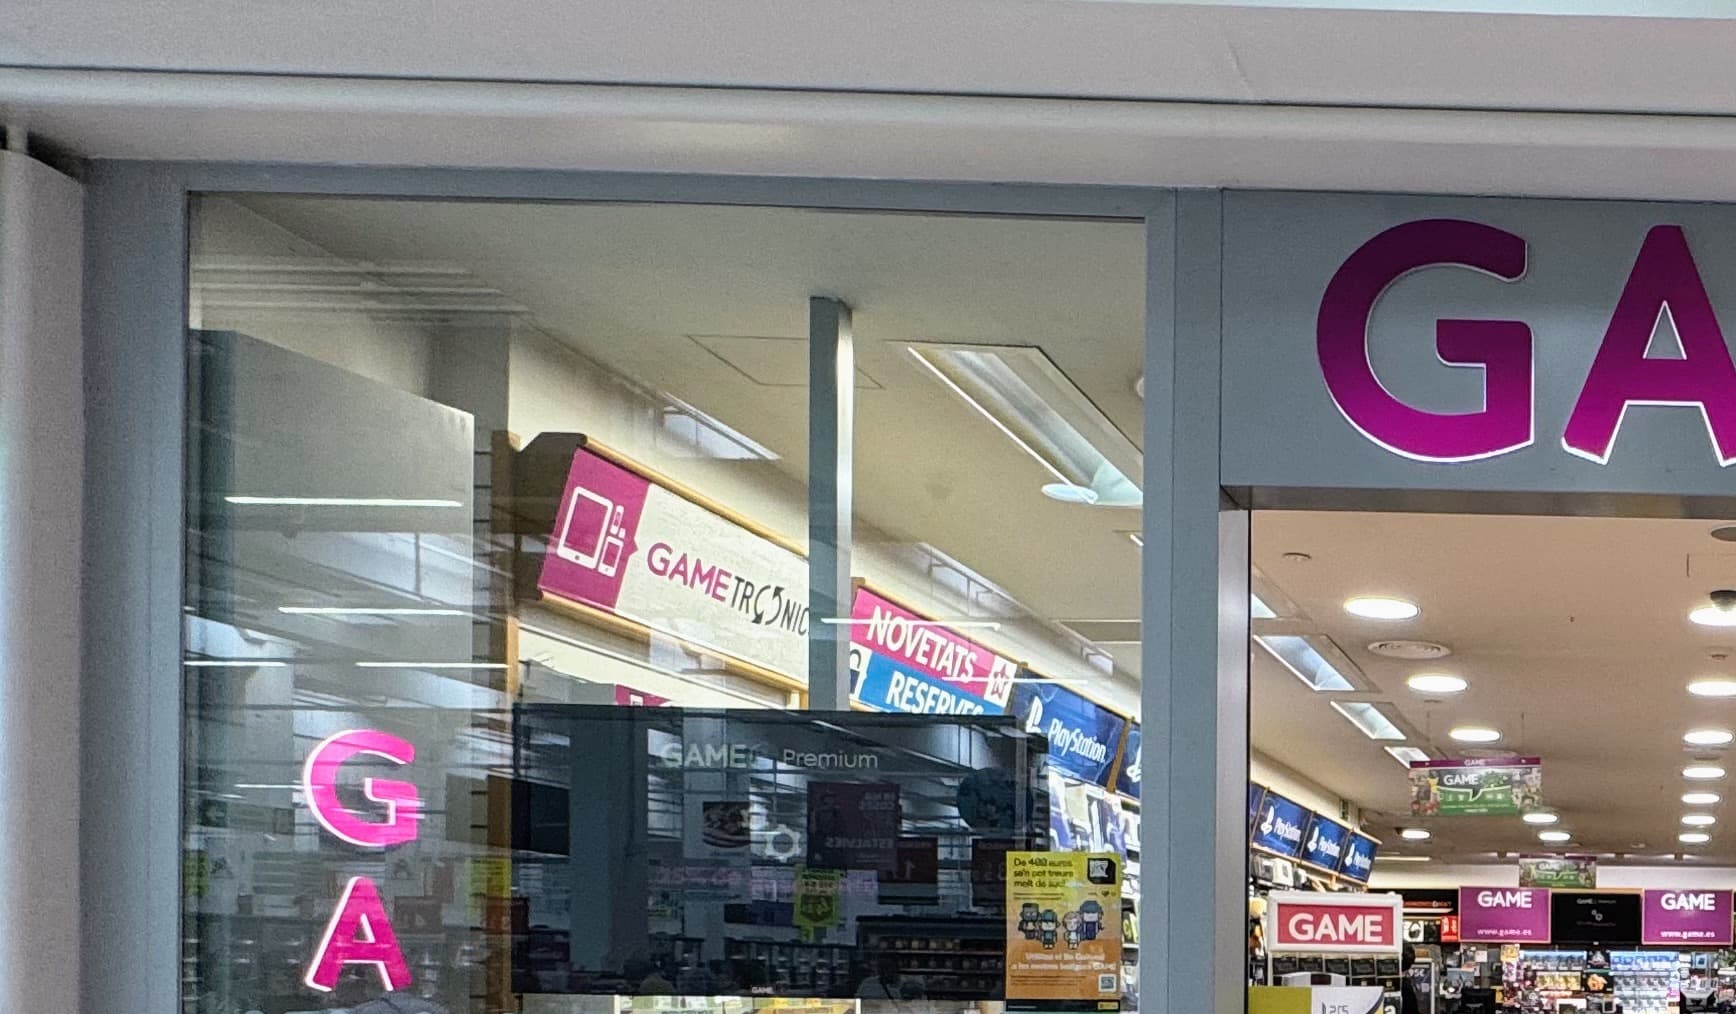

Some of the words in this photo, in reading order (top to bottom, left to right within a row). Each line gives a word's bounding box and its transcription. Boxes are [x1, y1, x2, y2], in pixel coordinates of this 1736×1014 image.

[866, 605, 977, 682] NOVETATS
[1049, 718, 1107, 762] PlayStation
[662, 743, 746, 768] GAME
[783, 748, 878, 769] Premium
[1443, 775, 1479, 785] GAME
[1477, 891, 1532, 908] GAME
[1661, 893, 1716, 911] GAME
[1289, 913, 1383, 942] GAME
[1477, 929, 1532, 937] www.game.es
[1661, 930, 1716, 939] www.game.es
